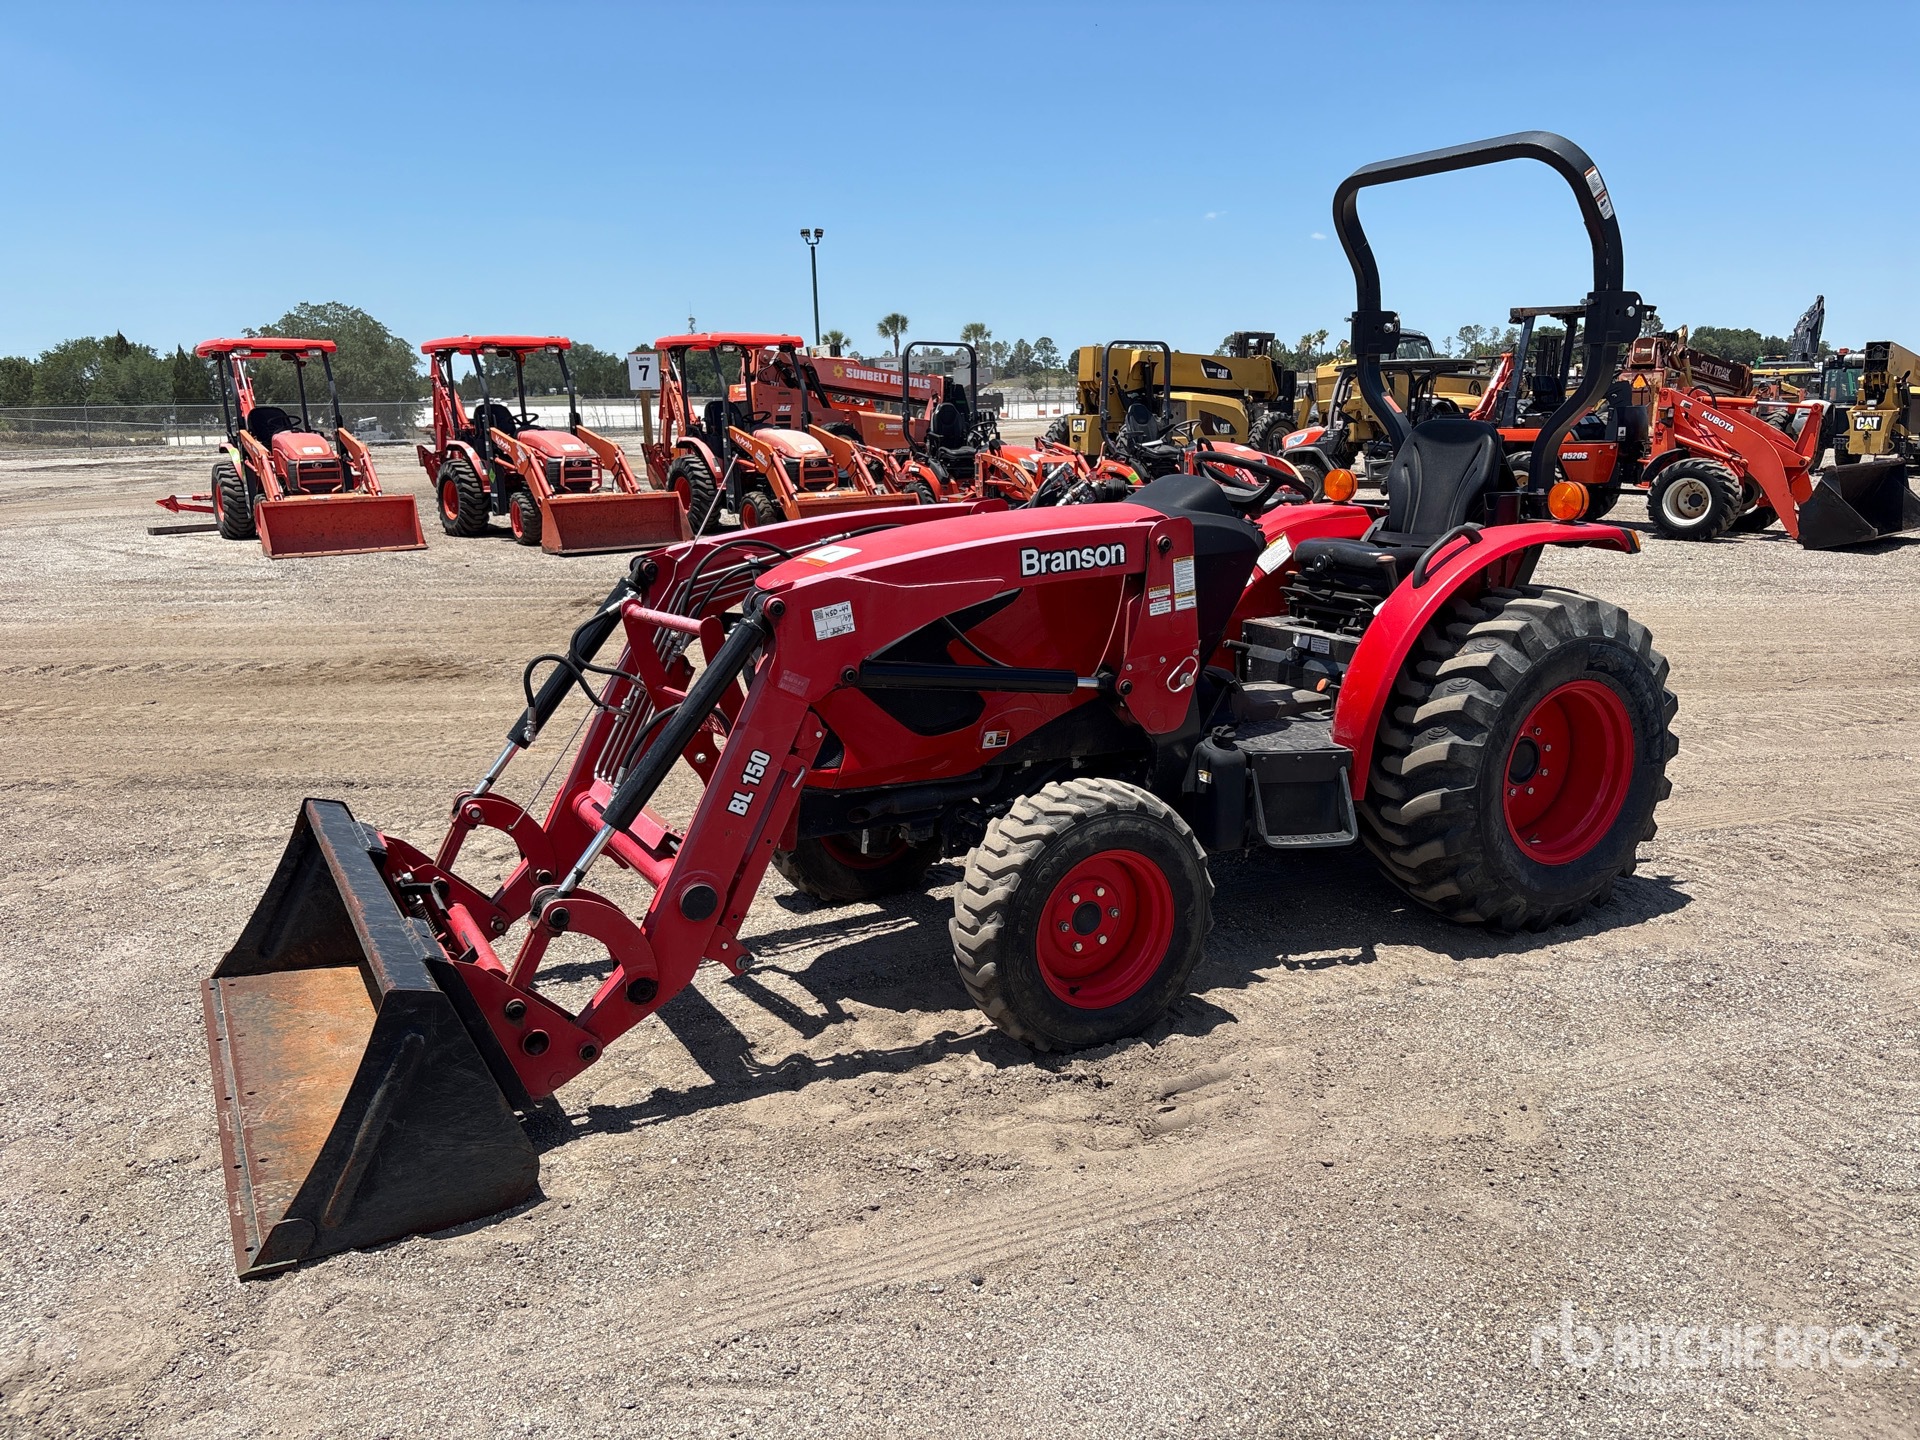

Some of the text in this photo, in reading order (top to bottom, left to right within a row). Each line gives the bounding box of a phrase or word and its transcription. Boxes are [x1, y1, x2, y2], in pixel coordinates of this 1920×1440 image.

[638, 365, 650, 381] 7
[1217, 368, 1229, 379] CAT
[1700, 361, 1715, 375] SKY
[846, 368, 931, 389] SUNBELT RETALS
[777, 404, 792, 412] JLG
[1219, 423, 1231, 434] CAT
[1701, 410, 1735, 433] KUBOTA
[1856, 416, 1880, 430] CAT
[1562, 451, 1589, 460] R520S
[1020, 543, 1126, 577] Branson
[727, 749, 772, 817] BL 150
